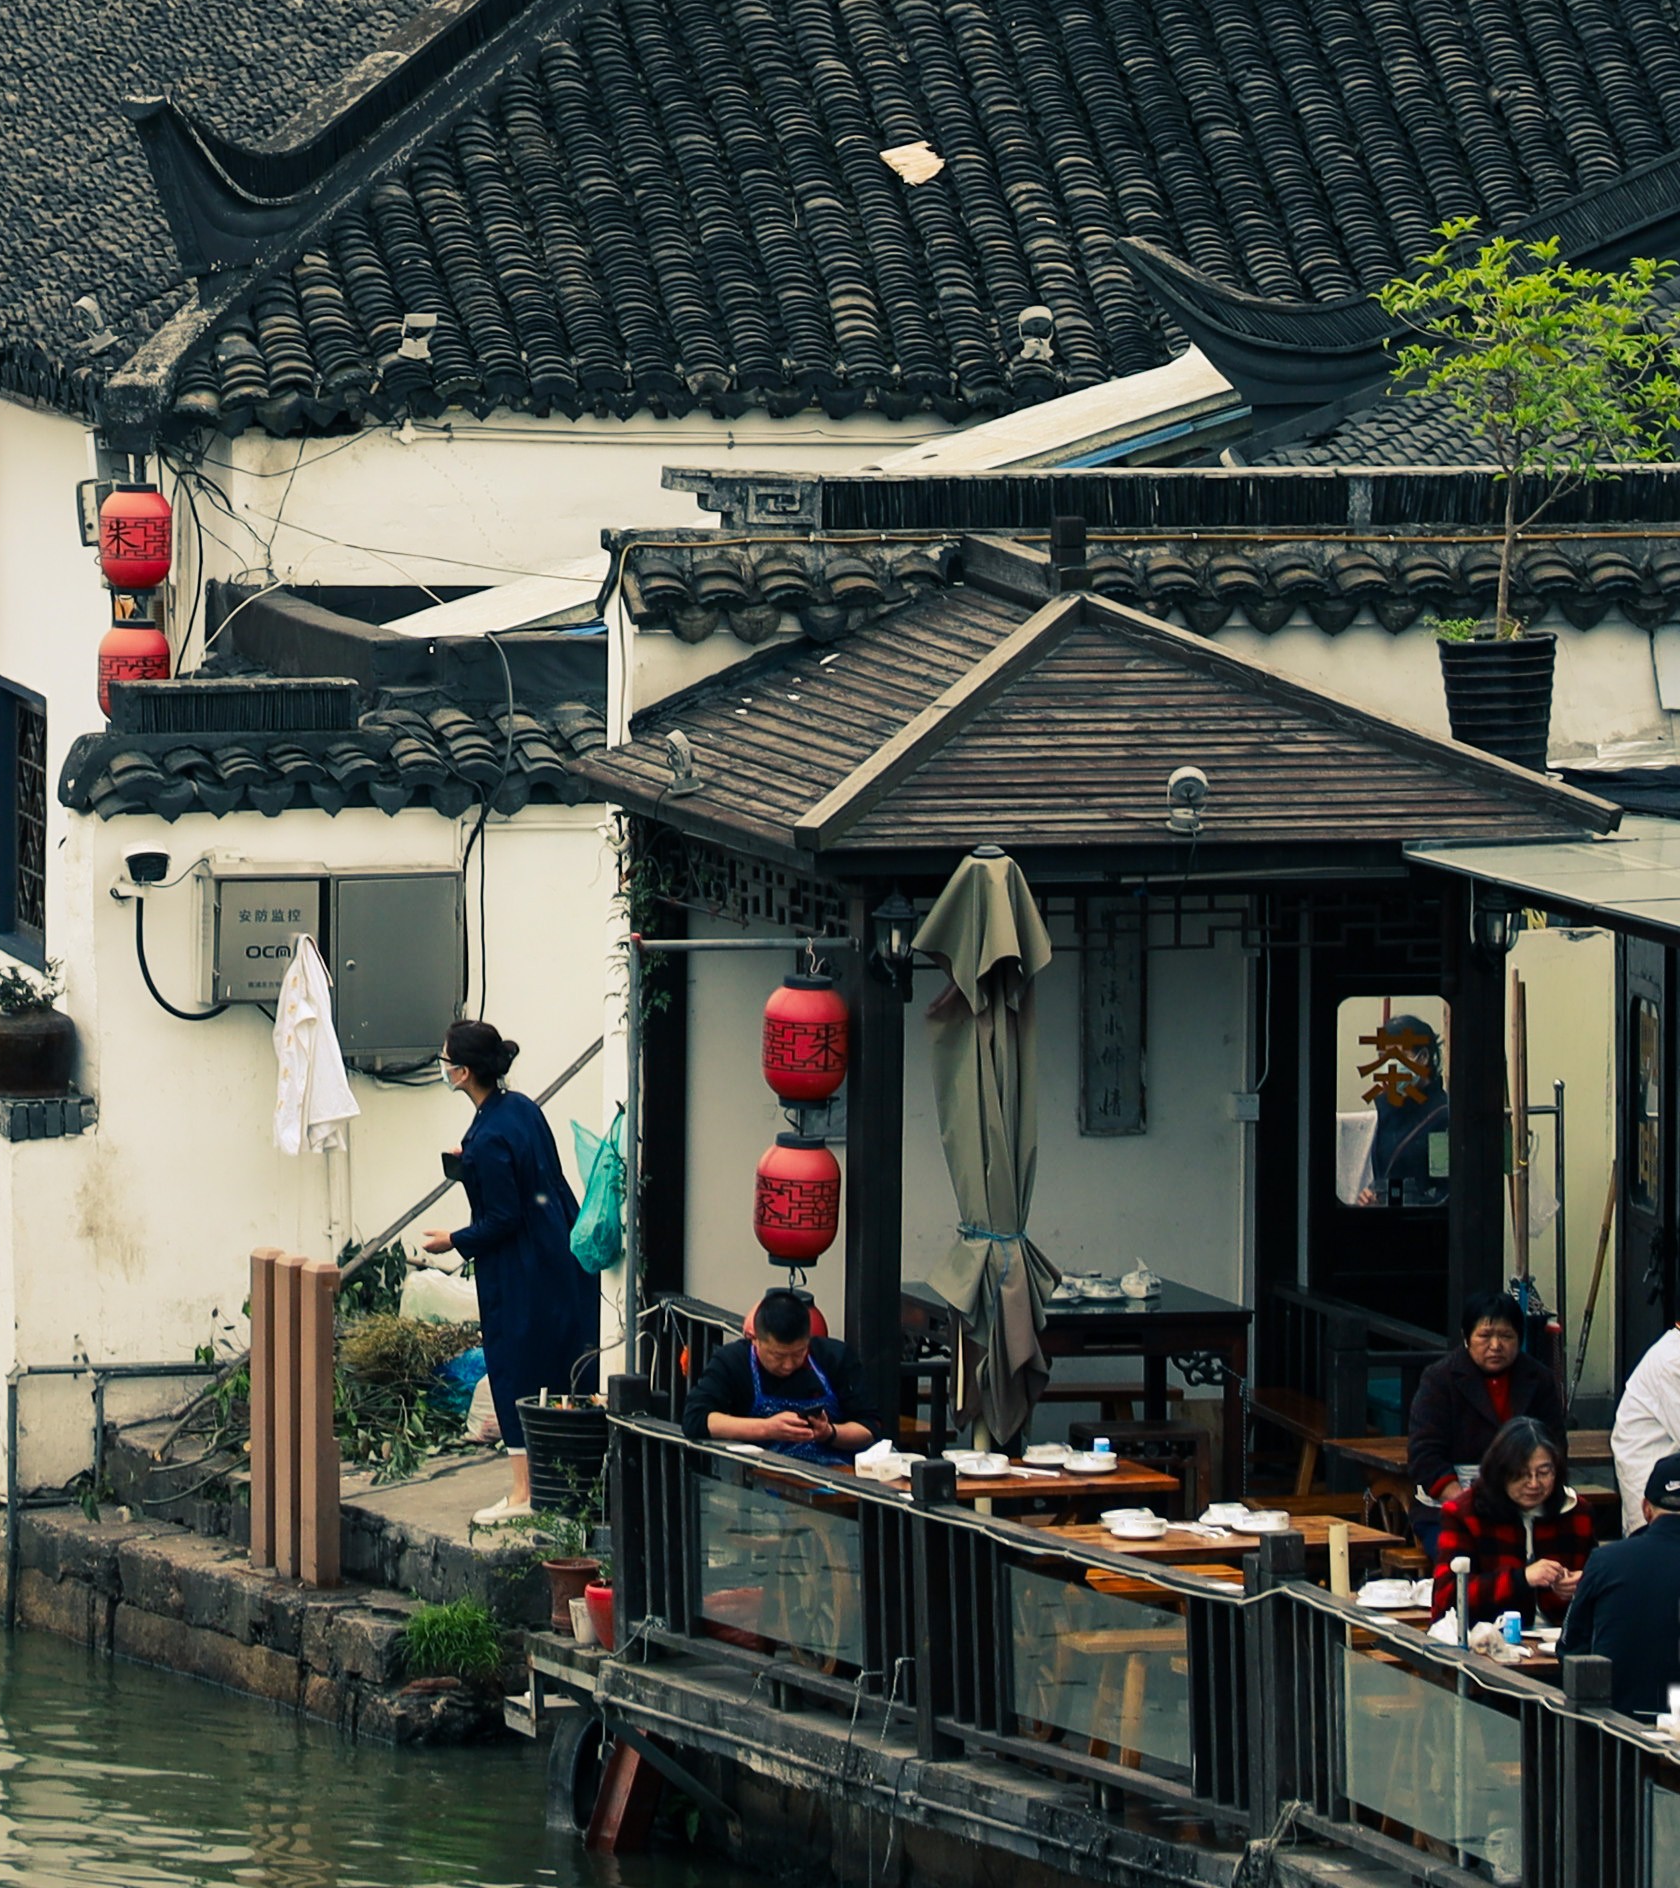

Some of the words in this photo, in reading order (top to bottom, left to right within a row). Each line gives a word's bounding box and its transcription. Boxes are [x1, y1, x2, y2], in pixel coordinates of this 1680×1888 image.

[106, 518, 141, 559] 朱
[238, 908, 301, 923] 安防监控
[806, 1023, 845, 1073] 朱
[1357, 1027, 1431, 1108] 茶
